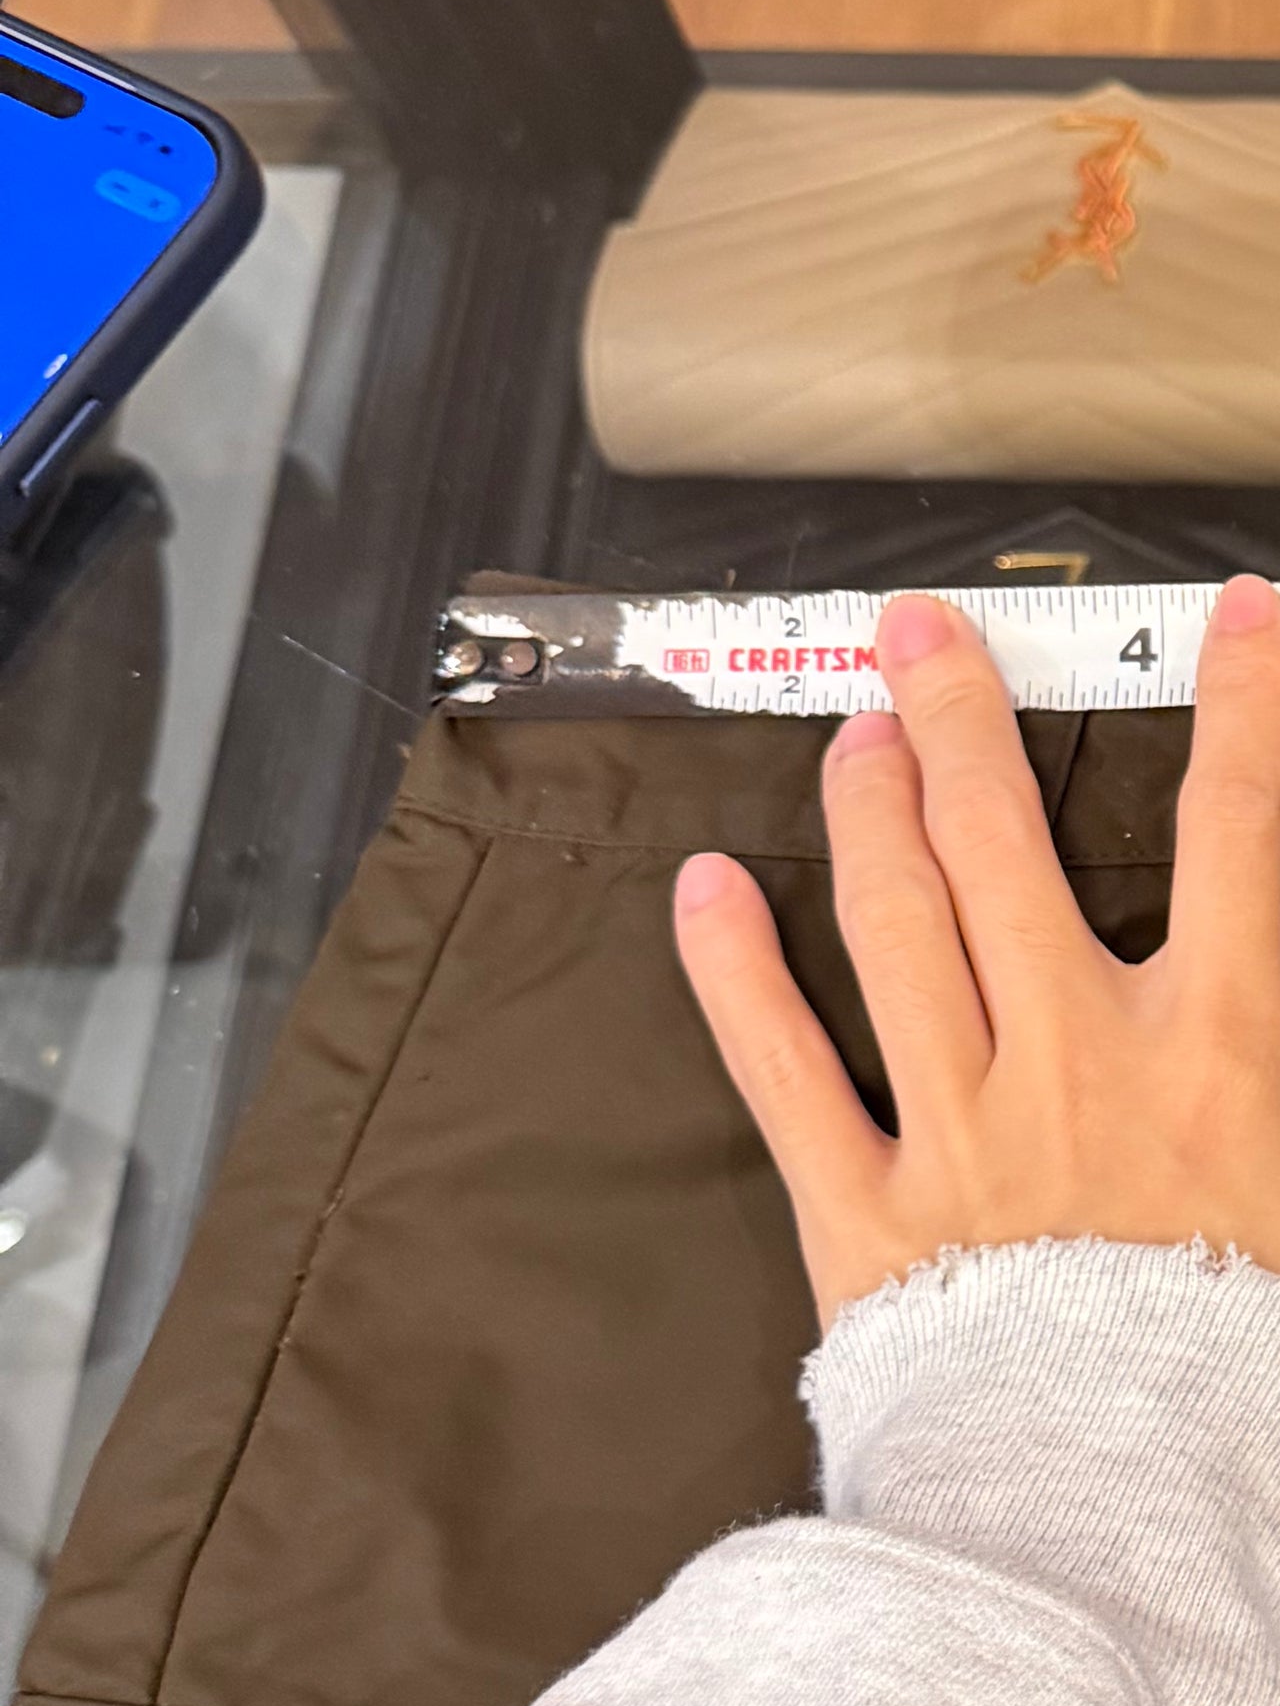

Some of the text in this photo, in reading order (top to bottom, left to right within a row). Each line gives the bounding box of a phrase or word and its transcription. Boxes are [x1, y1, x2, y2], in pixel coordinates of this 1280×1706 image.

[784, 617, 803, 638] 2
[728, 646, 880, 672] CRAFTSM
[1118, 627, 1159, 673] 4
[783, 674, 802, 694] 2
